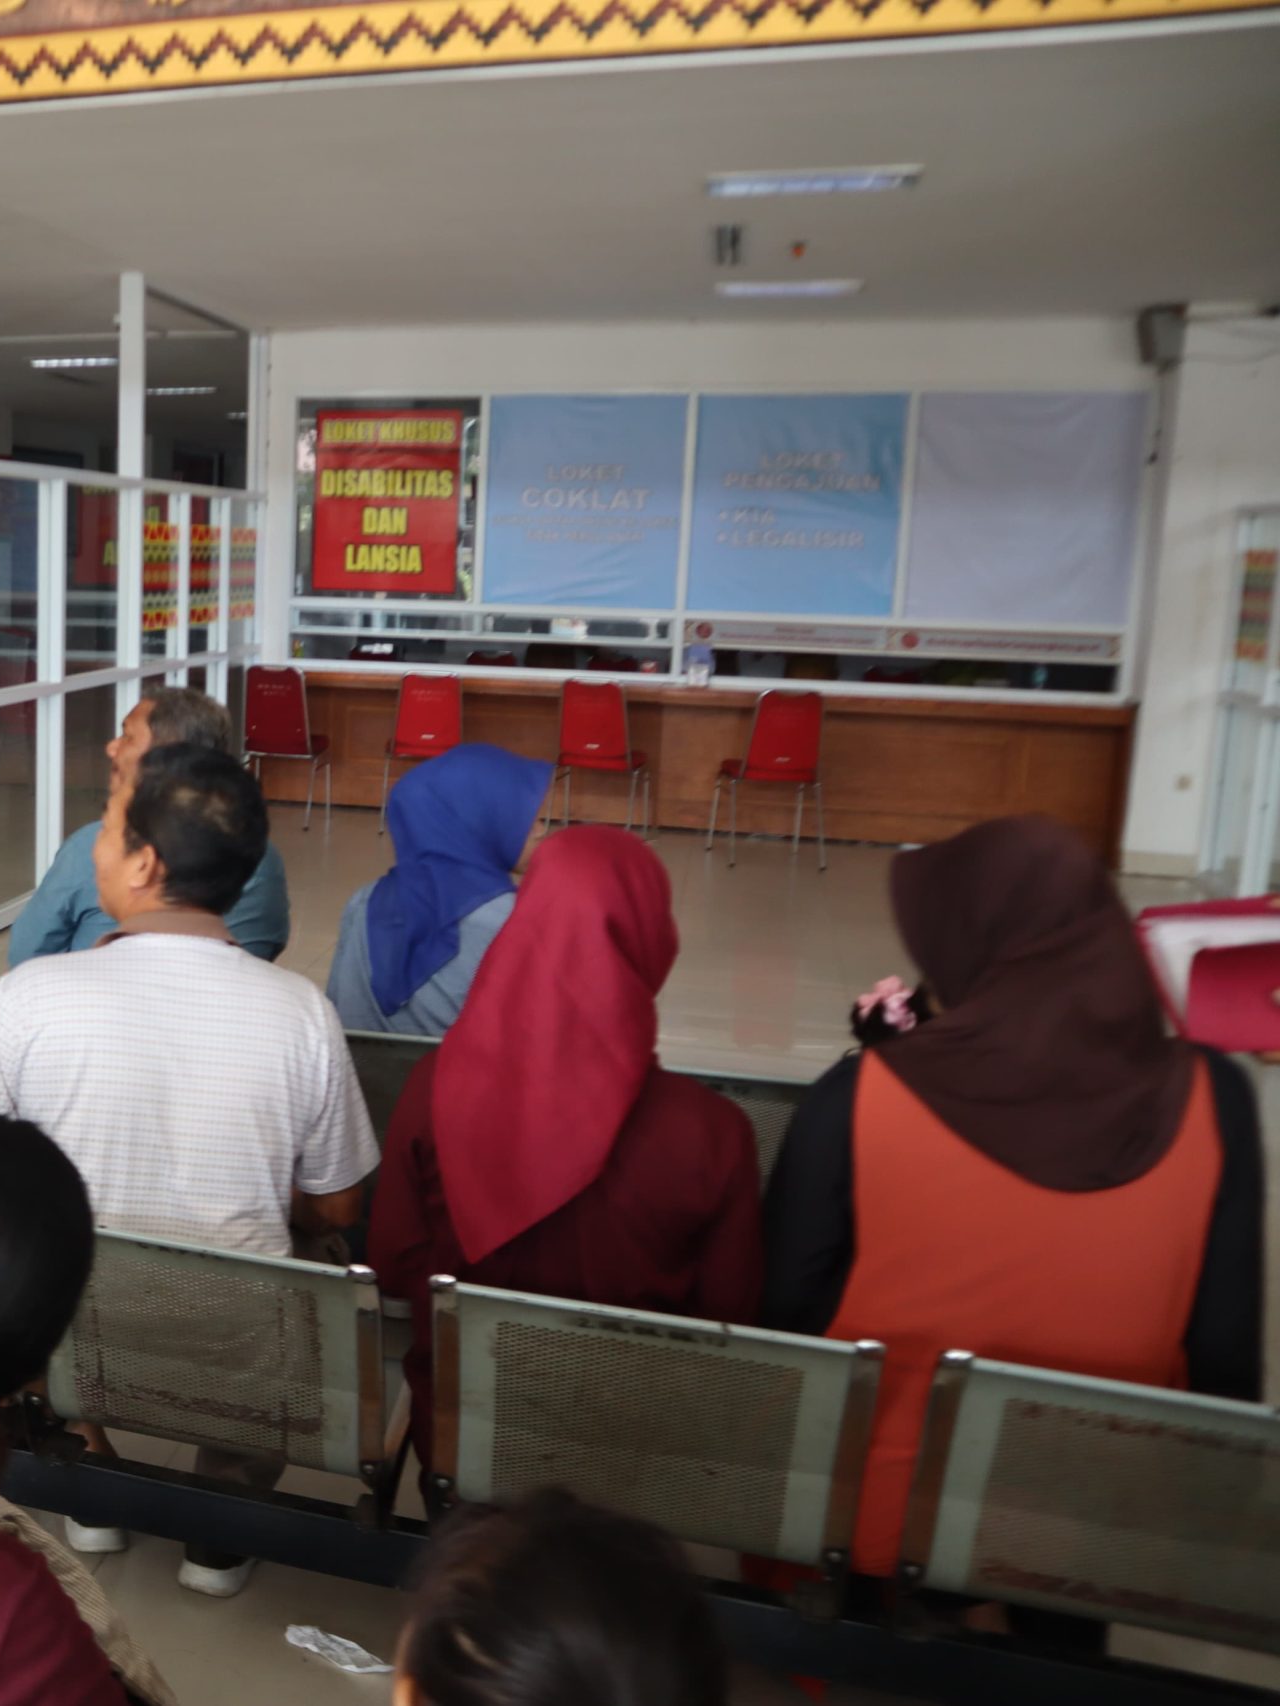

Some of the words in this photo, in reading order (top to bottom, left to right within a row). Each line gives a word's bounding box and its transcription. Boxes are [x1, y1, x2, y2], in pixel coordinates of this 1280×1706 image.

[322, 419, 374, 443] LOKET
[379, 419, 456, 443] KHUSUS
[320, 469, 454, 498] DISABILITAS
[545, 464, 626, 481] LOKET
[521, 486, 651, 512] COKLAT
[361, 506, 408, 535] DAN
[732, 529, 865, 549] LEGALISIR
[345, 543, 423, 573] LANSIA
